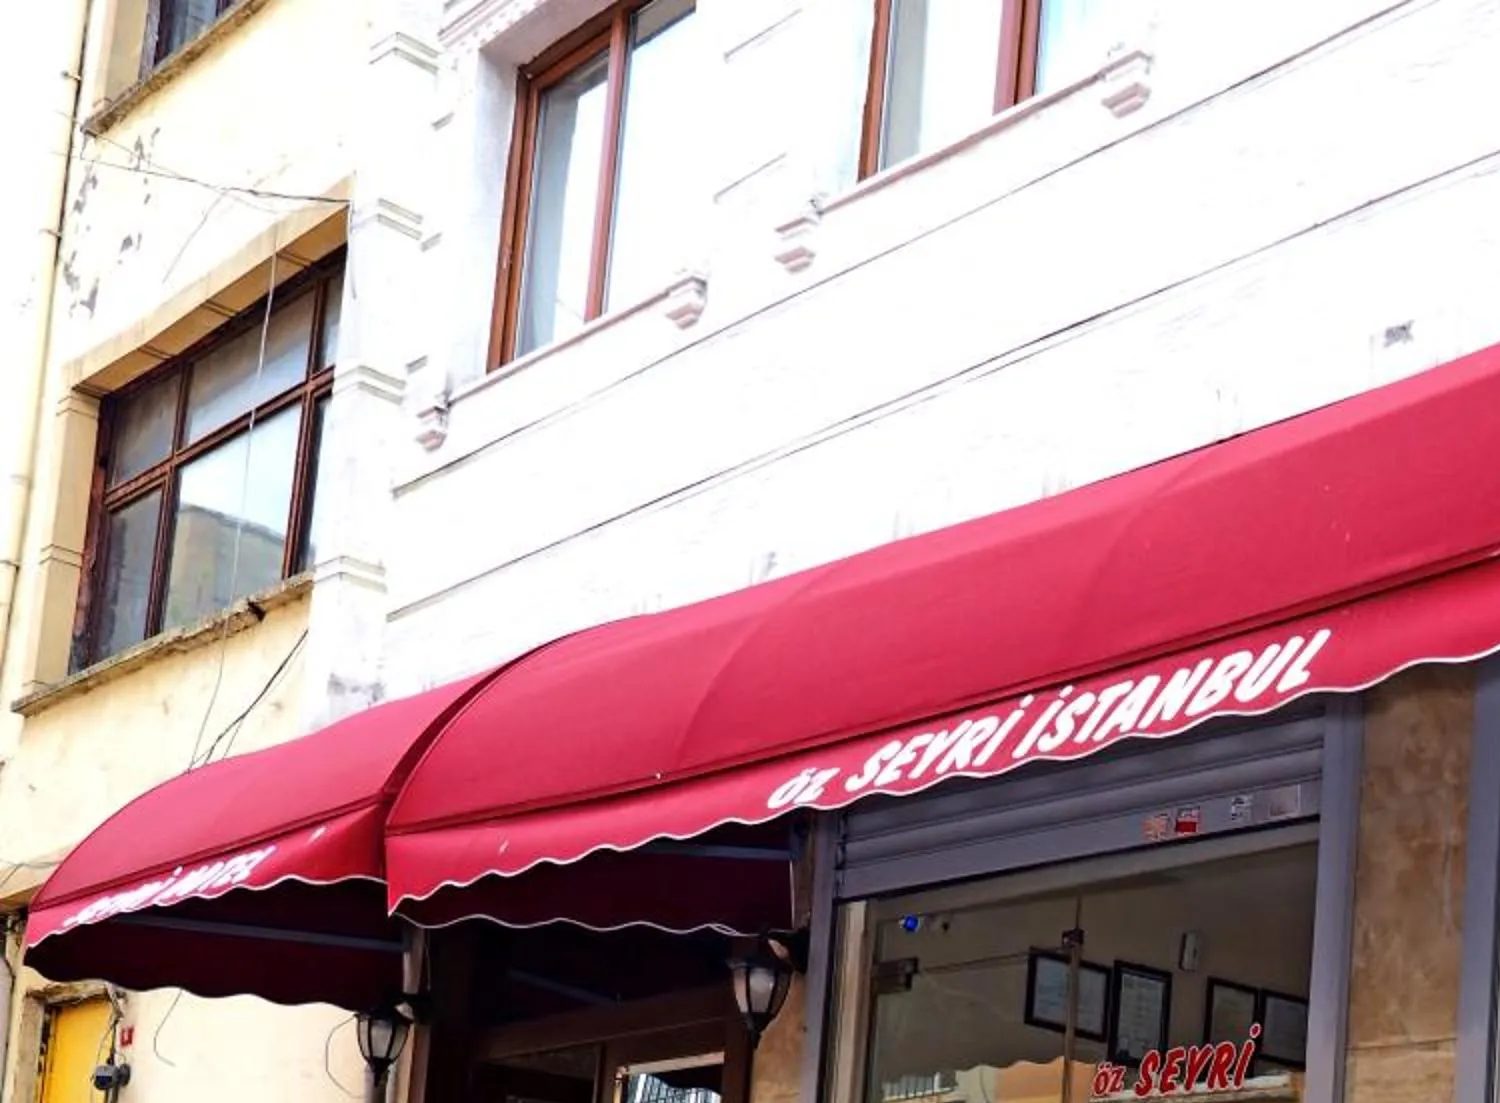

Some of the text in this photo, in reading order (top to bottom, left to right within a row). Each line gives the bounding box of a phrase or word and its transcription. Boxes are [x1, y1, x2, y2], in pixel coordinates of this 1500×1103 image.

[767, 628, 1332, 809] ÖZ SEYRİ İSTANBUL
[1092, 1022, 1262, 1098] ÖZ SEYRİ
